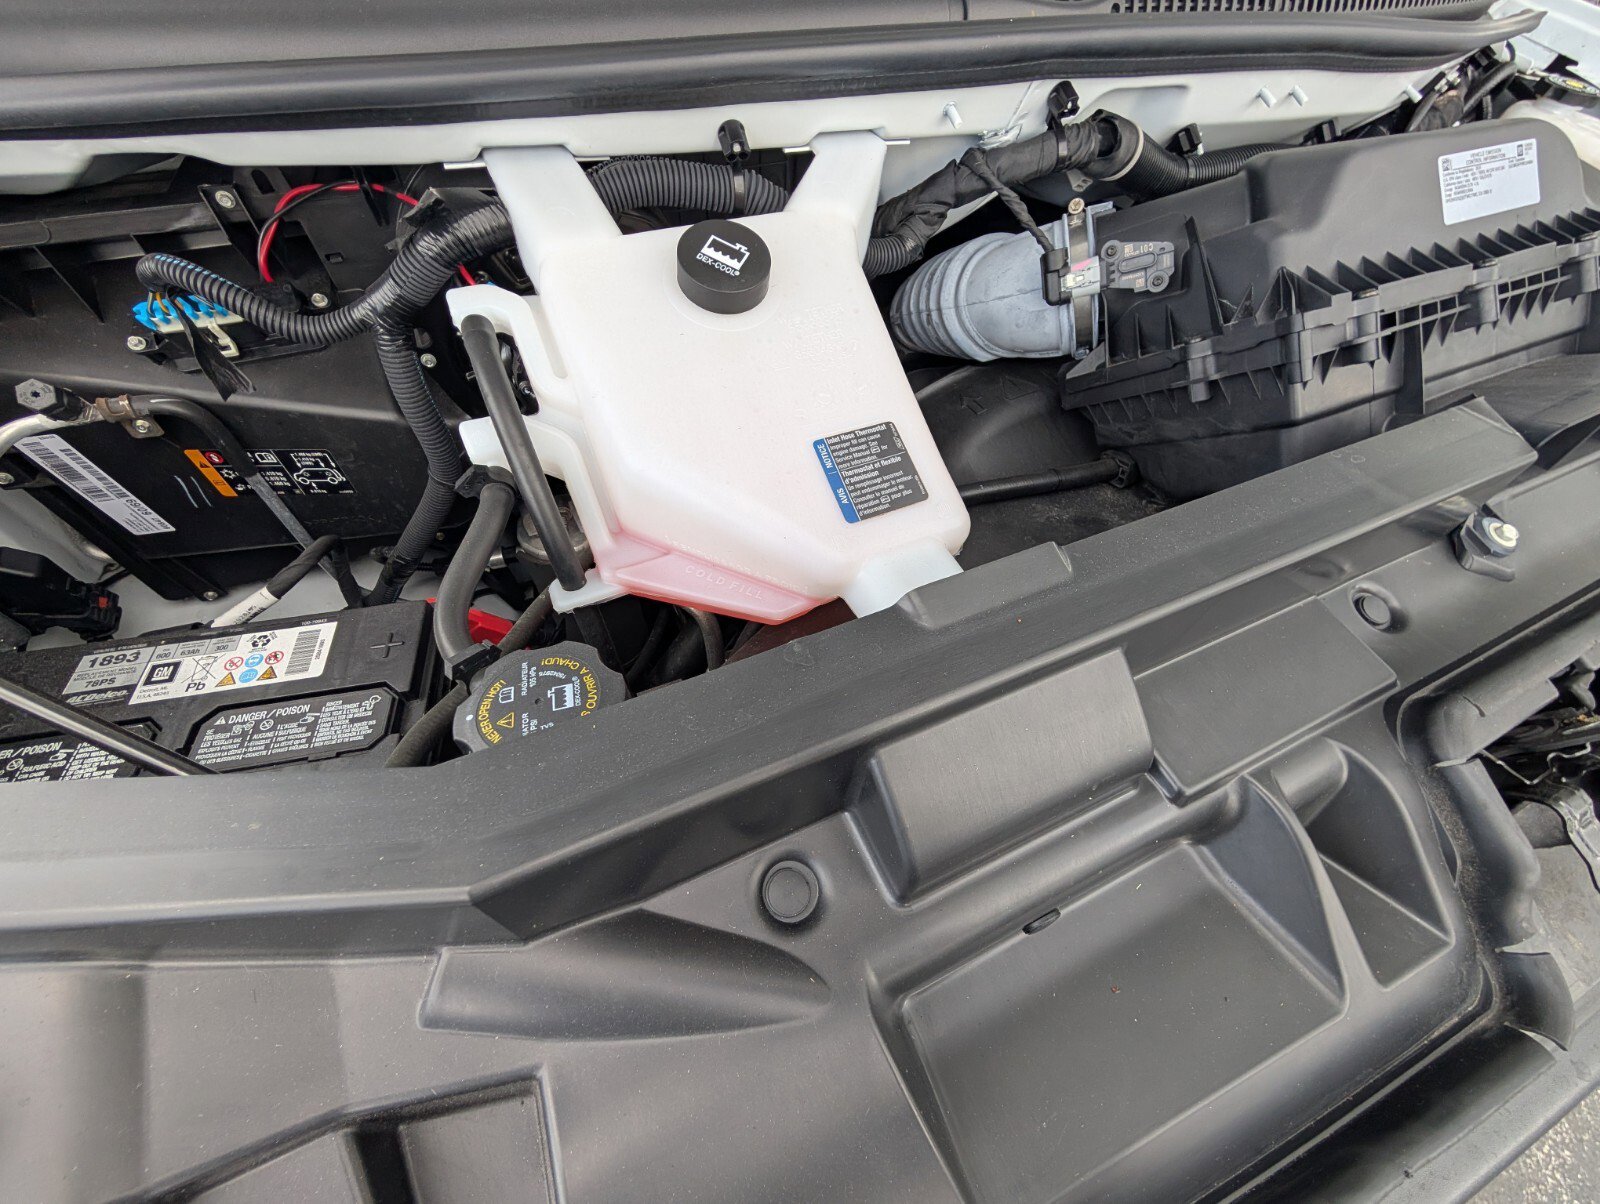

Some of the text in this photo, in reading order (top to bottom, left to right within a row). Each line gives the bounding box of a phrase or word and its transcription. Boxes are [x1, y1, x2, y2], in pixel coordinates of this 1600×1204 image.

[696, 253, 737, 276] DEX-COOL
[855, 424, 887, 436] Thermostat
[830, 441, 850, 450] Improper
[817, 444, 833, 468] NOTICE
[853, 449, 870, 458] Manual
[841, 464, 874, 477] Thermostat
[880, 456, 901, 466] flexible
[845, 470, 879, 484] d'admission
[837, 488, 849, 503] AVIS
[685, 564, 763, 600] COLD FILL
[89, 651, 140, 668] 1893
[541, 657, 580, 670] CHAUD!
[153, 665, 174, 677] GM
[85, 677, 116, 688] 78PS
[185, 682, 206, 692] Pb
[583, 674, 597, 709] OUVRIR
[478, 680, 506, 744] NEVER OPEN HOT!
